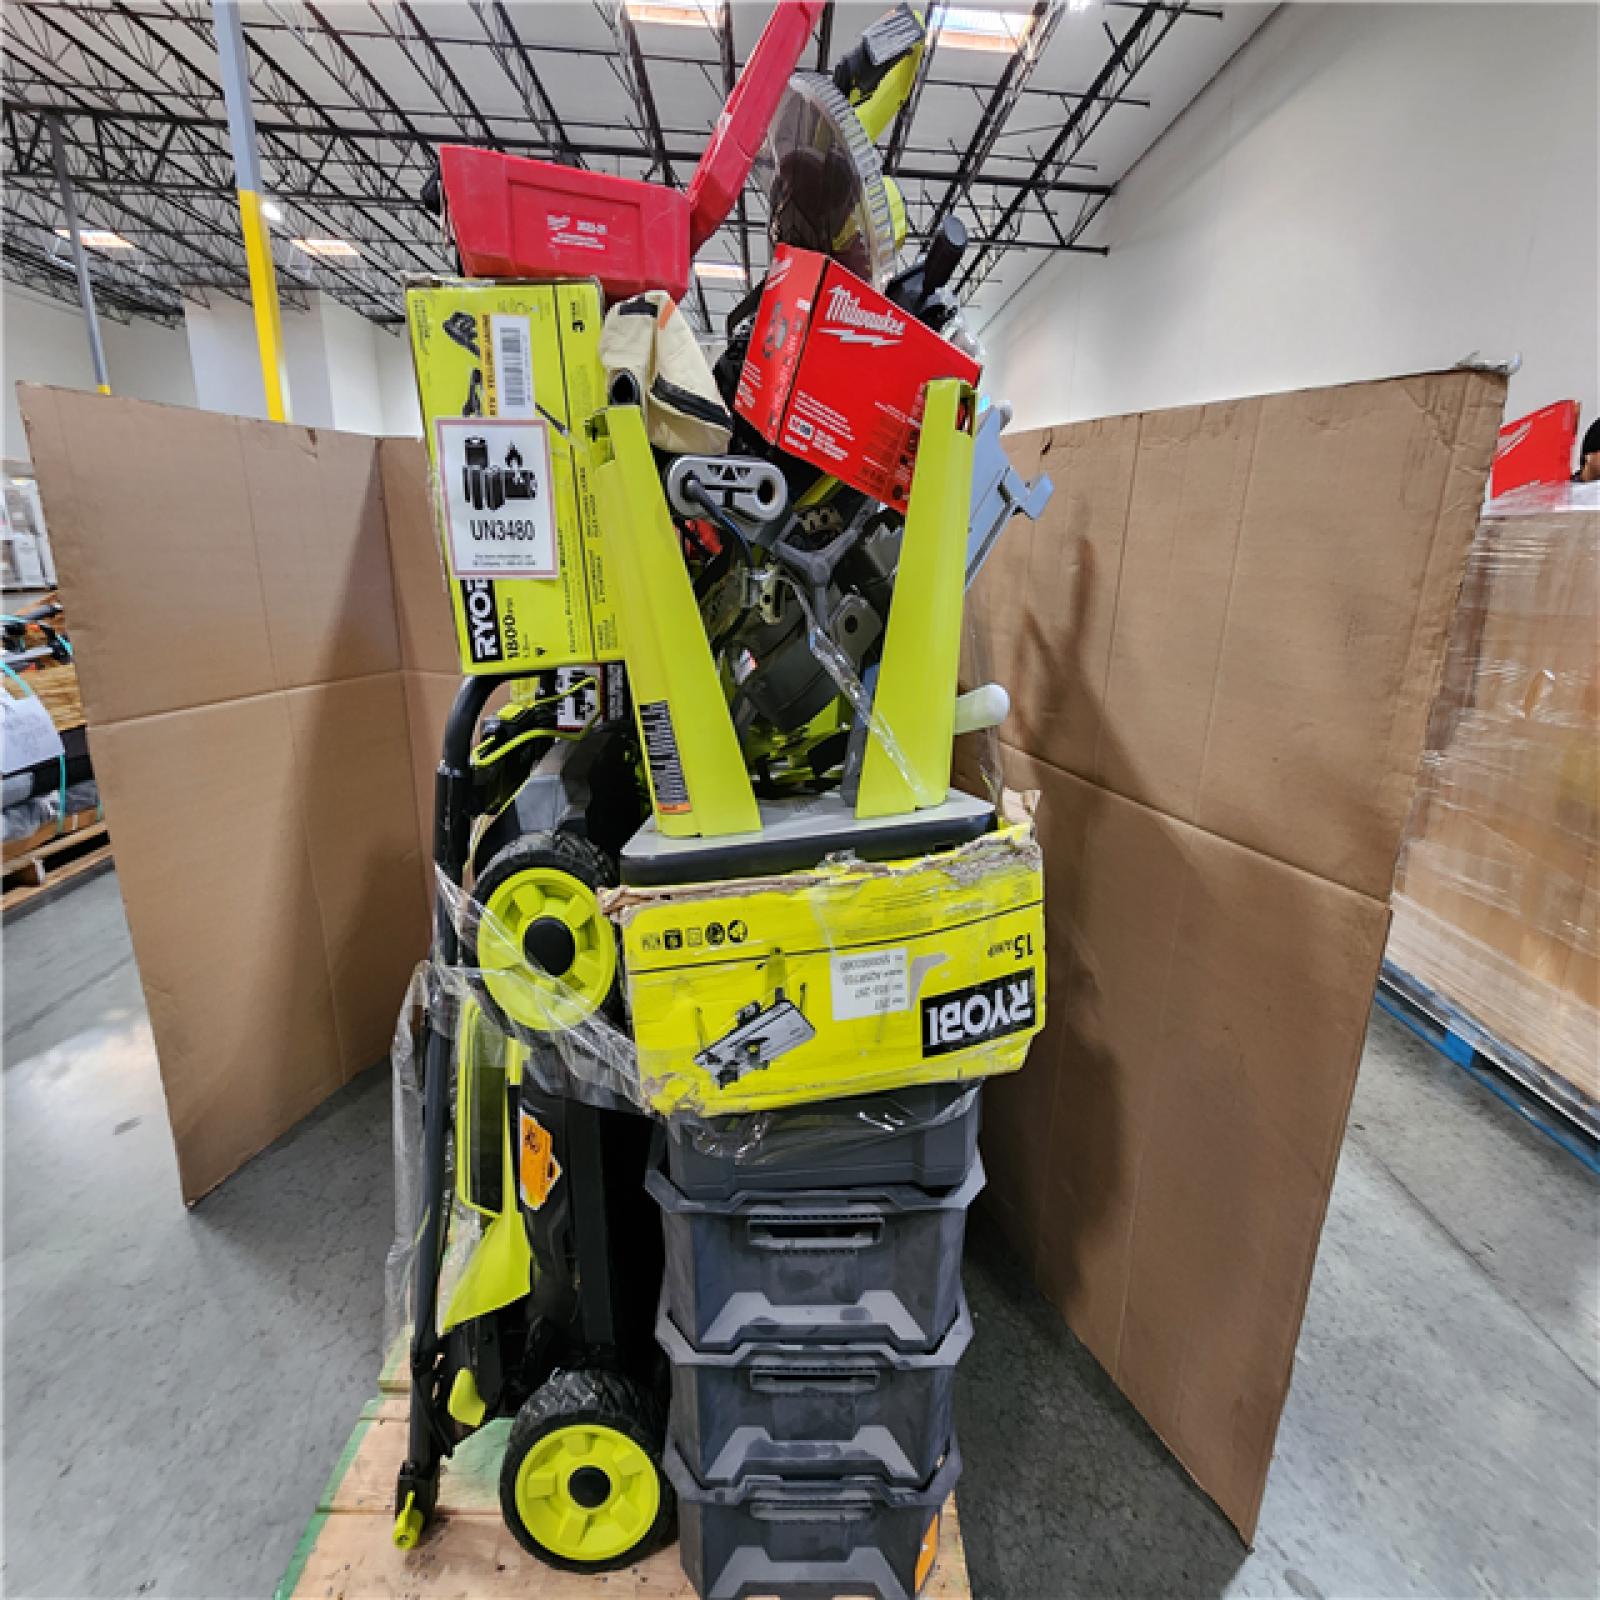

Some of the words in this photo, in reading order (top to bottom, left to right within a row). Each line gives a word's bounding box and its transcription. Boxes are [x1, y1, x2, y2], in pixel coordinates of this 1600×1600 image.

[824, 285, 906, 335] Milwaukee
[469, 519, 536, 541] UN3480
[465, 577, 499, 659] RYOB
[1014, 931, 1033, 961] 15
[928, 978, 1032, 1046] RYOBI
